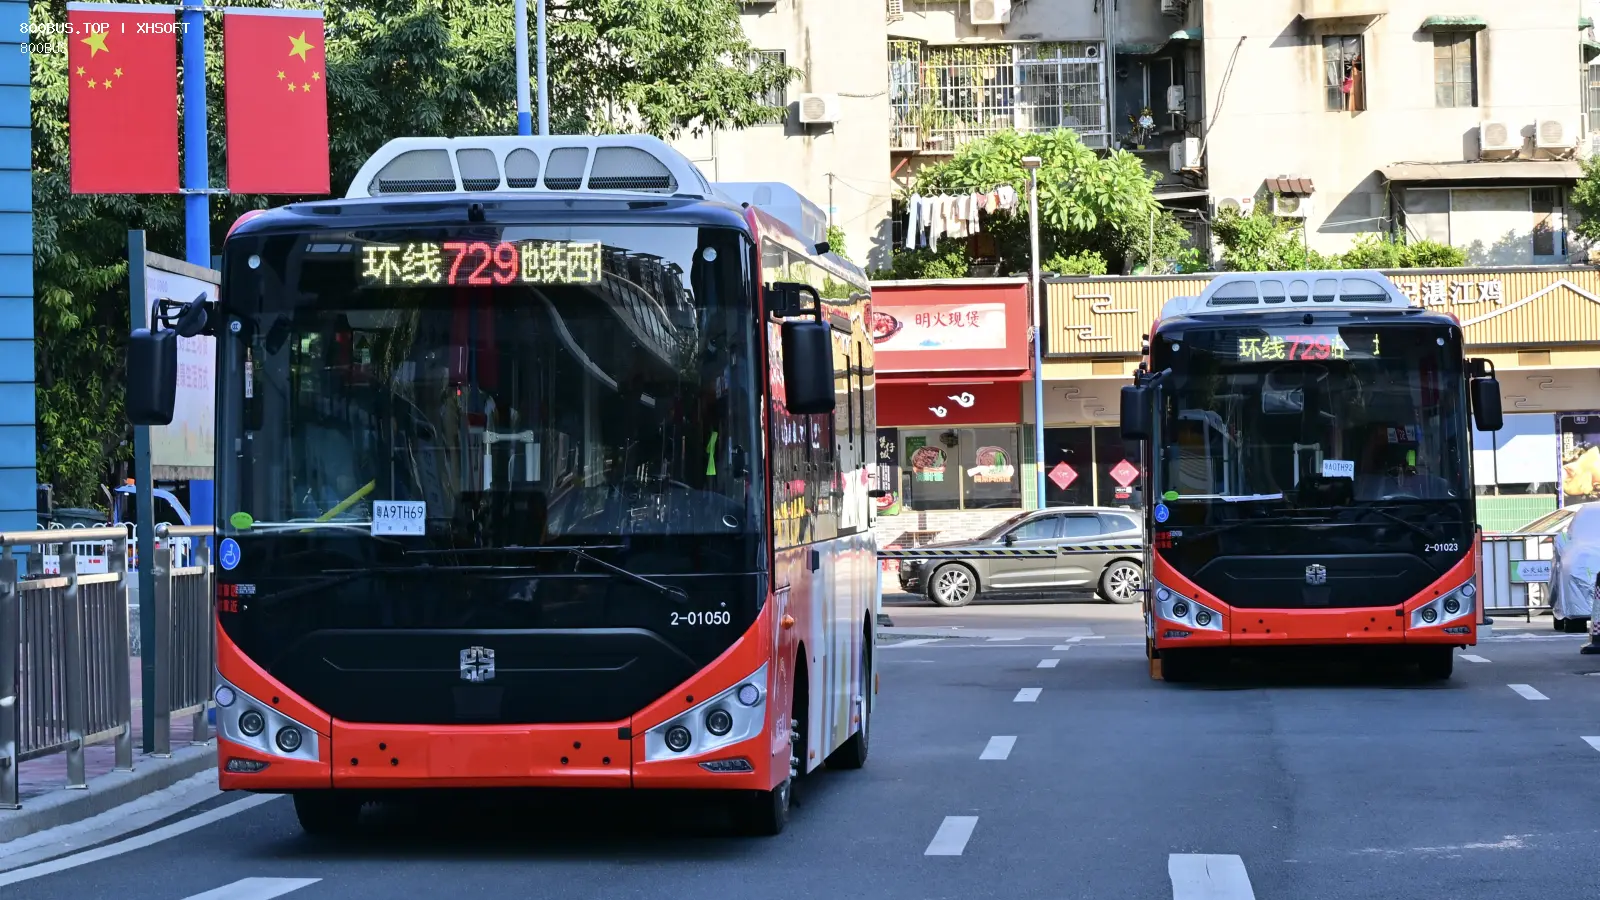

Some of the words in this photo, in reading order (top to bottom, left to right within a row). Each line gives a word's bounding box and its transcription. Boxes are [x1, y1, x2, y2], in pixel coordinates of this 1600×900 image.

[915, 311, 980, 329] 明火现煲
[1424, 543, 1459, 552] 2-01023
[670, 611, 731, 626] 2-01050
